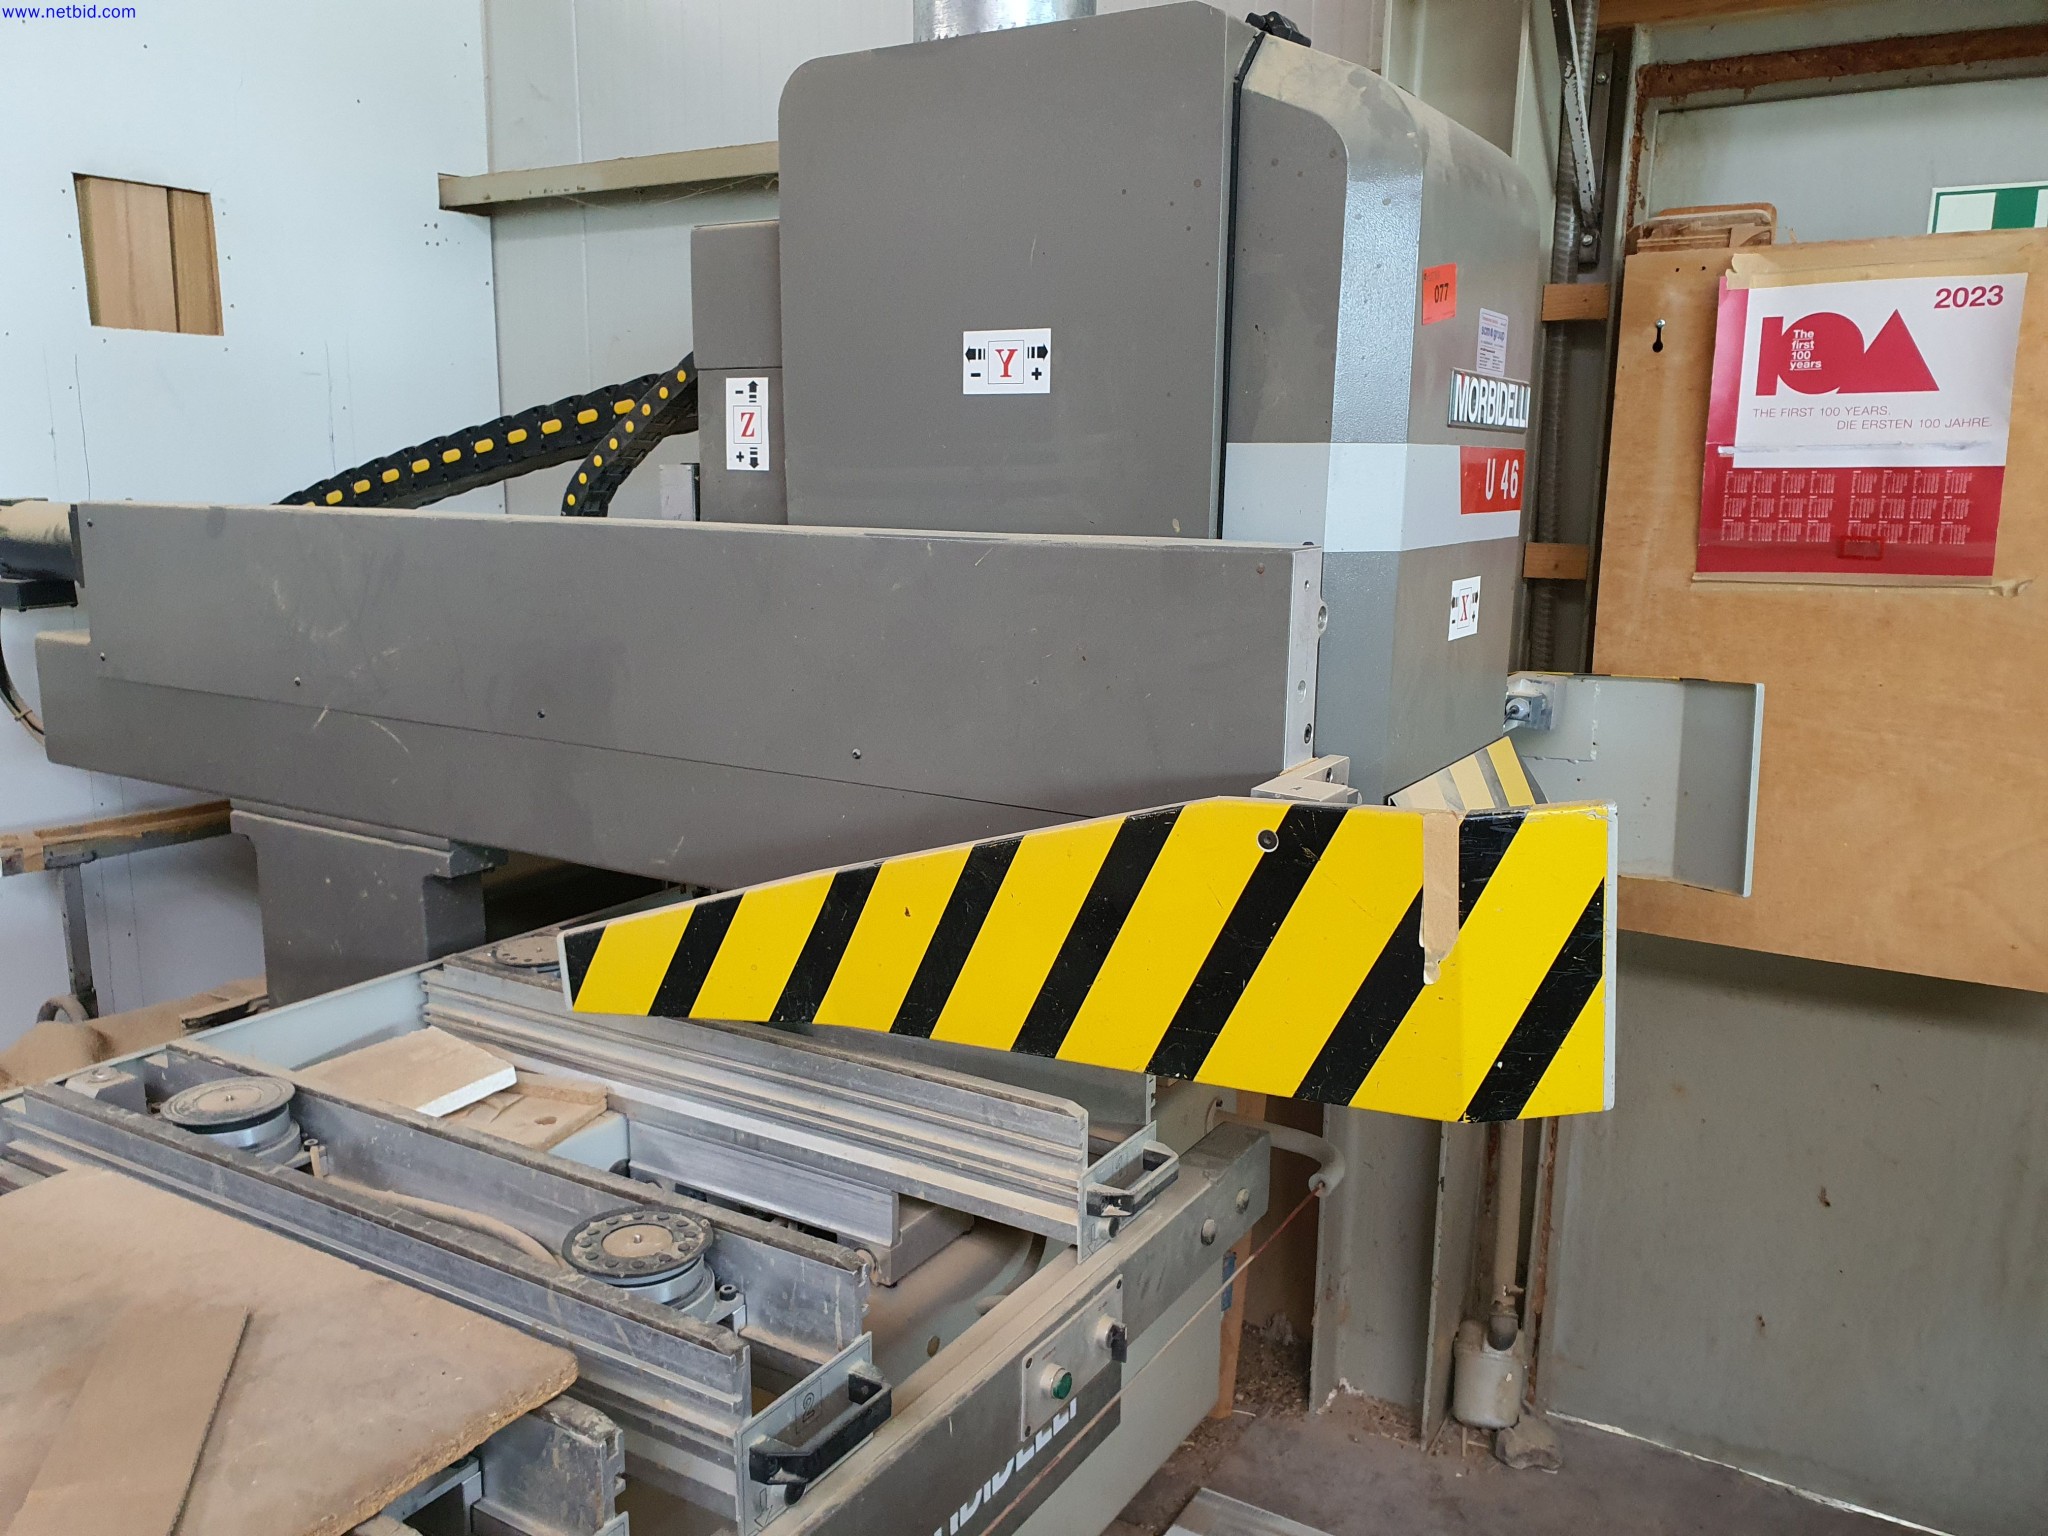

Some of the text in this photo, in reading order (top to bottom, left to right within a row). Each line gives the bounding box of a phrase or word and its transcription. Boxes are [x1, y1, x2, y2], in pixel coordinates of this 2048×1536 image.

[1434, 282, 1449, 304] 077
[1934, 285, 2004, 309] 2023
[1793, 328, 1815, 339] The
[1791, 340, 1815, 350] first
[995, 348, 1018, 378] Y
[1791, 350, 1811, 360] 100
[1789, 360, 1822, 371] years
[1453, 373, 1531, 428] MORBIDELLI
[1753, 407, 1776, 418] THE
[1780, 407, 1815, 417] FIRST
[1821, 406, 1841, 417] 100
[740, 411, 756, 438] Z
[1837, 419, 1857, 430] DIE
[1862, 418, 1913, 430] ERSTEN
[1919, 418, 1941, 429] 100
[1485, 457, 1519, 501] U 46
